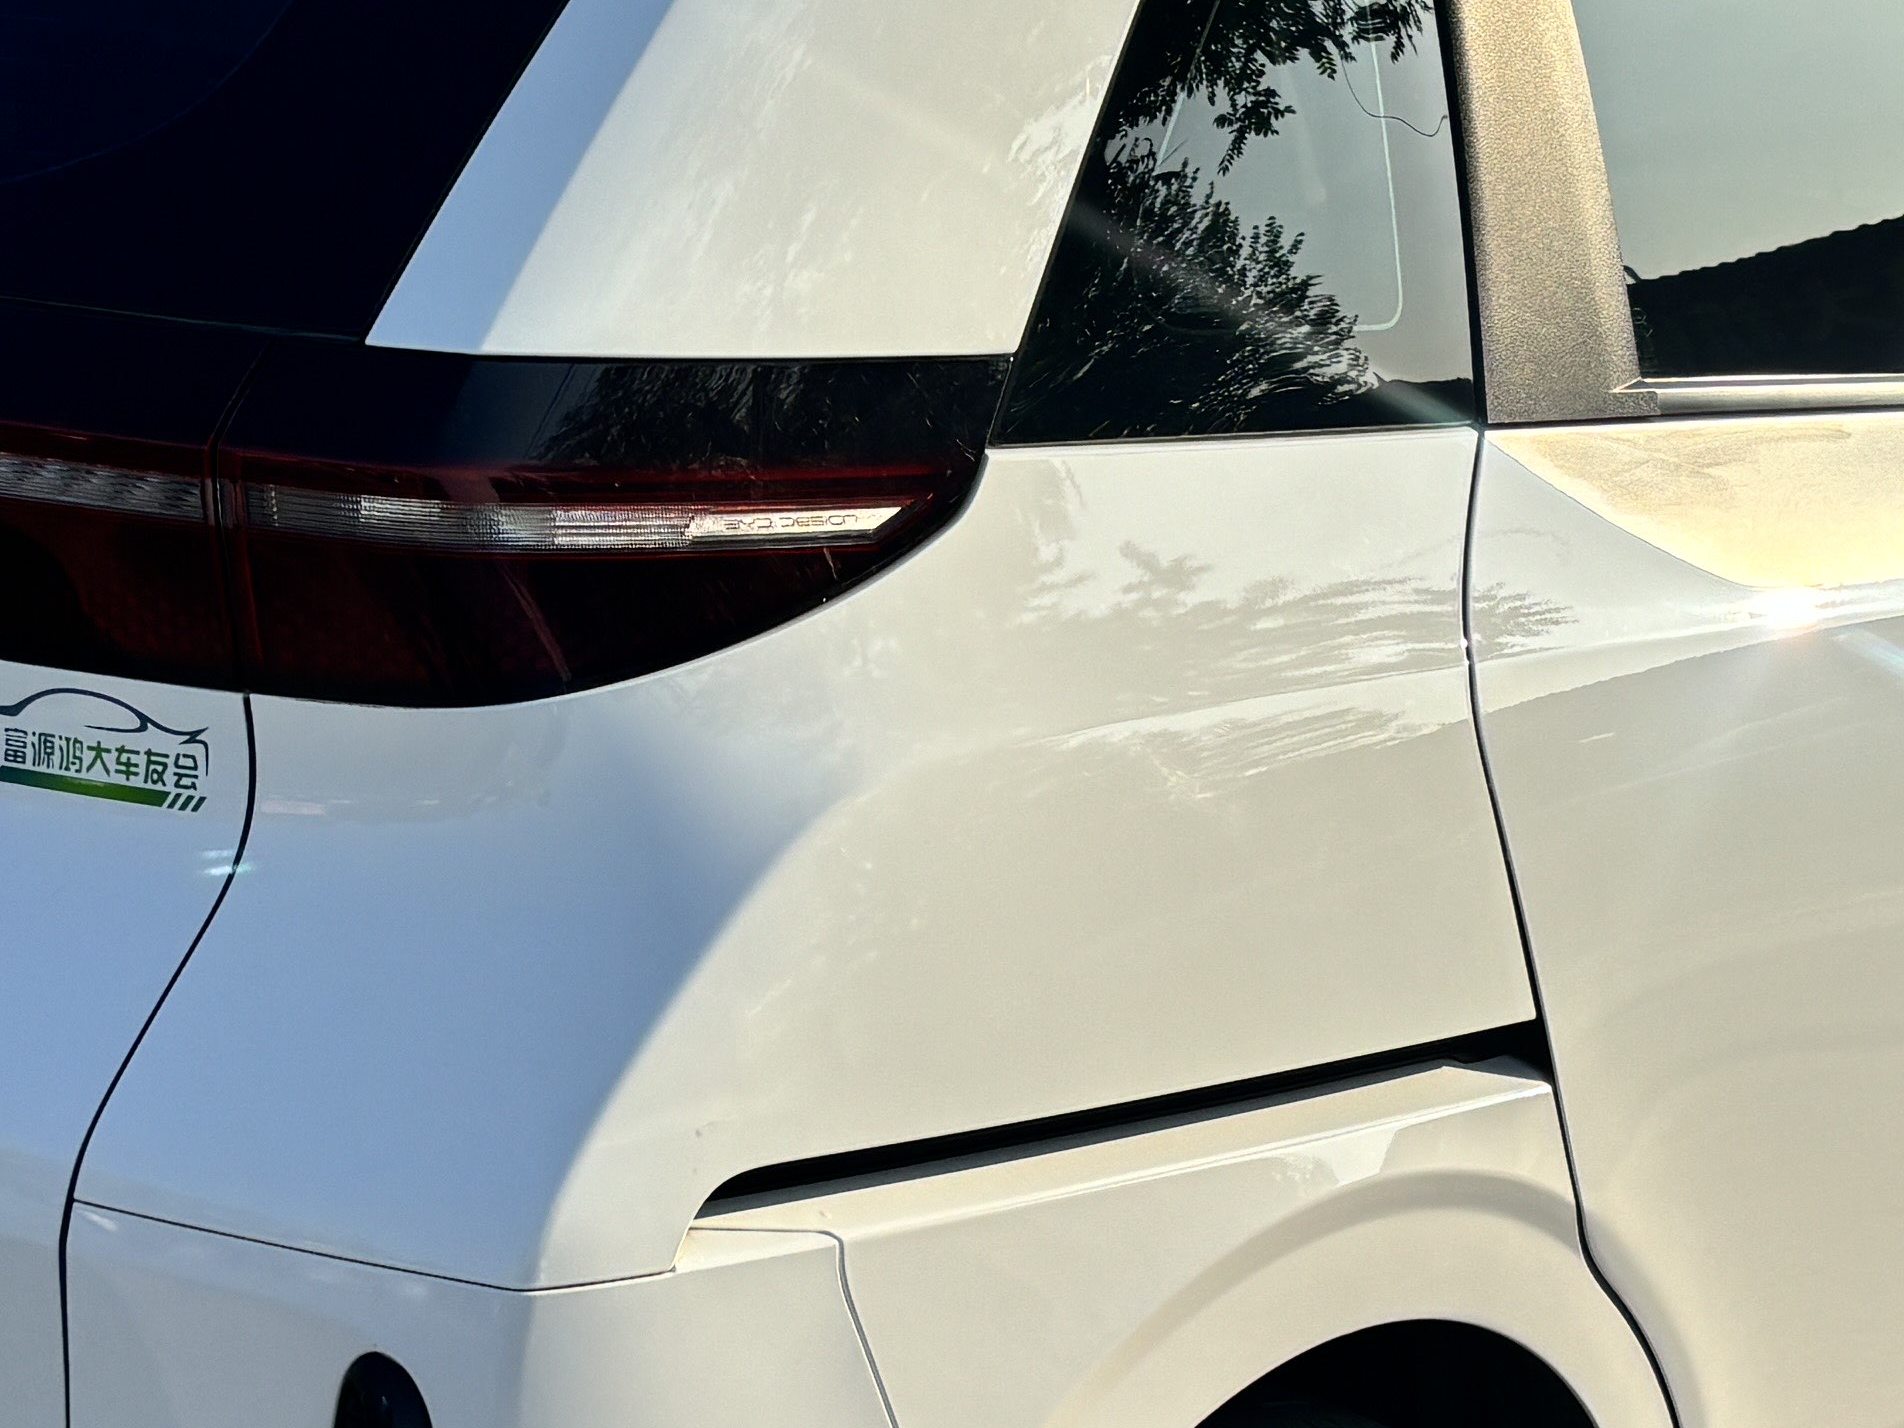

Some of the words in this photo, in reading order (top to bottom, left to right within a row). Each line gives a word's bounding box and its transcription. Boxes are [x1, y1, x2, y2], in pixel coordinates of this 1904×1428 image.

[3, 727, 199, 791] 富源鸿大车友会
